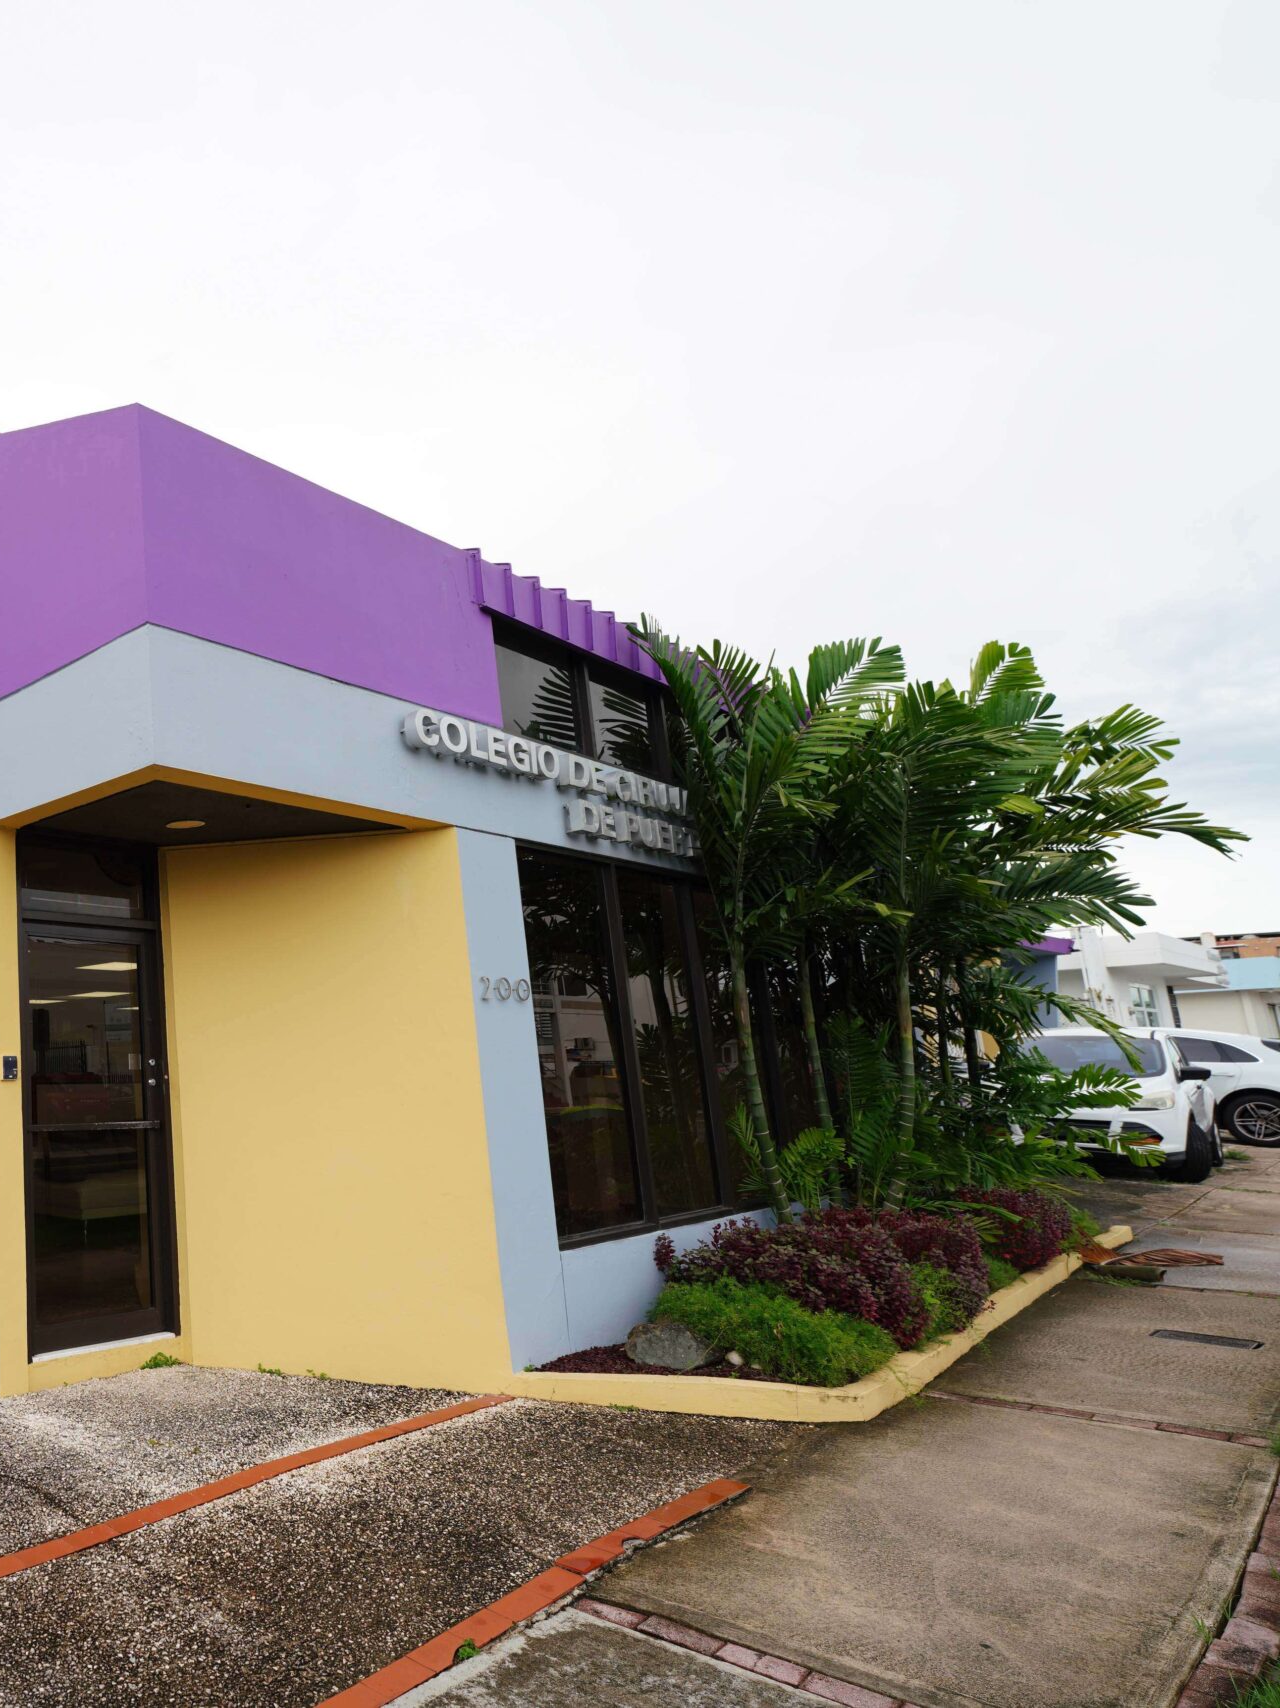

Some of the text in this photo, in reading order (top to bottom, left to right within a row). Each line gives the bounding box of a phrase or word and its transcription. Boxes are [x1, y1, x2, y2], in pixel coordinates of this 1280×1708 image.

[410, 708, 560, 779] COLEGIO
[564, 754, 608, 796] DE
[575, 799, 701, 857] DE PUERT
[480, 976, 530, 1001] 200
